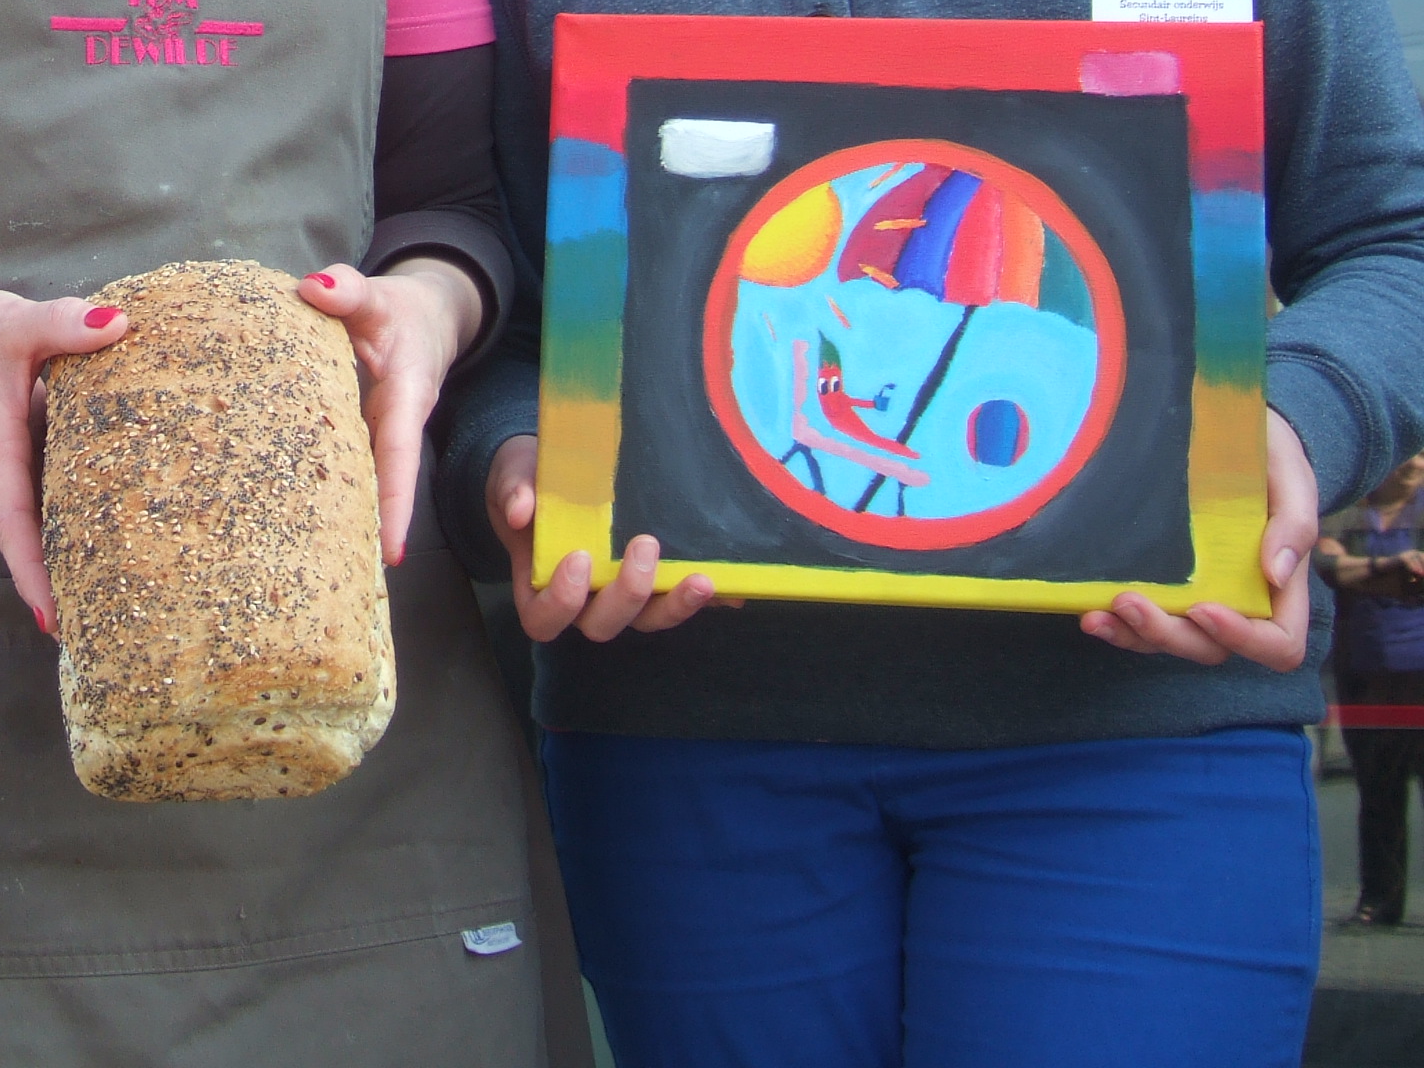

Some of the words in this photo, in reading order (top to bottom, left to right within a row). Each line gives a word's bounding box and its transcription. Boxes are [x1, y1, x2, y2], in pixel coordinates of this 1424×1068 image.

[1119, 0, 1171, 9] Secundair
[1173, 0, 1224, 10] onderwijs
[85, 34, 239, 66] DEWILDE
